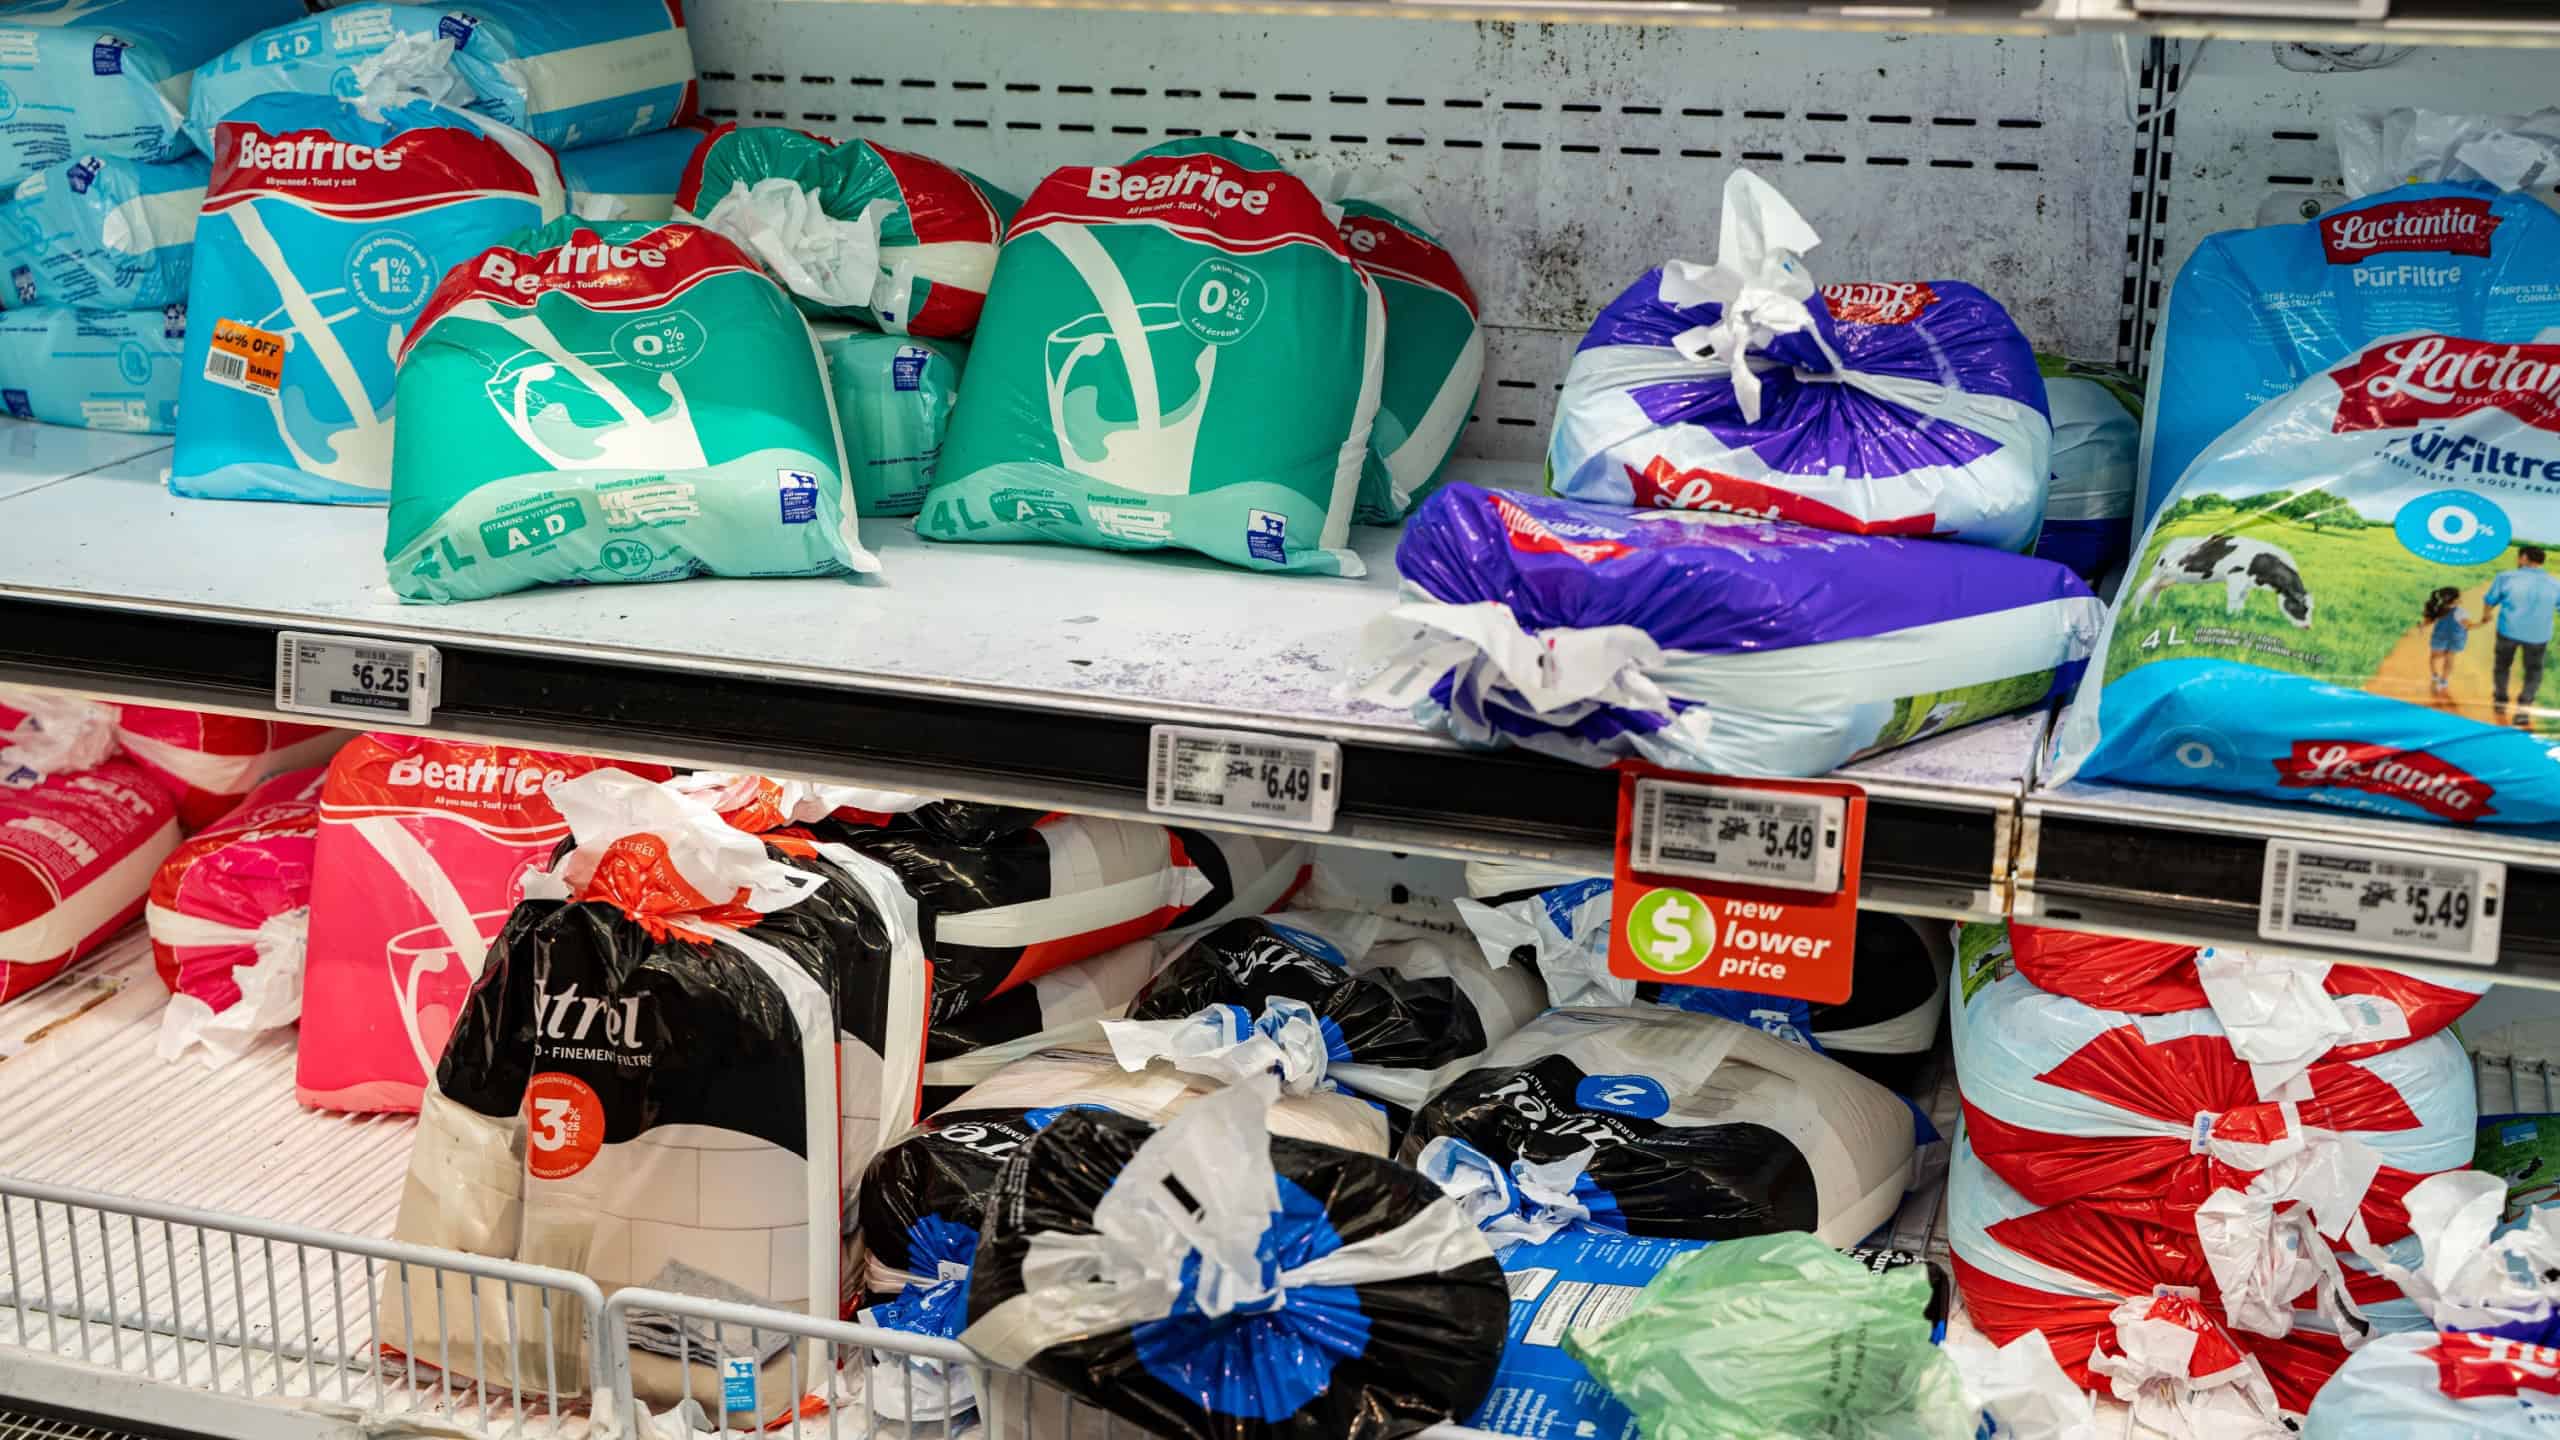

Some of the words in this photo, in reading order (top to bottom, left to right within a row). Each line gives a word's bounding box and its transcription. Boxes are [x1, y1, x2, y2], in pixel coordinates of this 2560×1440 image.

[238, 132, 402, 172] Beatrice
[1087, 164, 1270, 216] Beatrice
[2332, 207, 2477, 250] Lactantia
[479, 241, 667, 295] Betrice
[252, 337, 280, 357] OFF
[249, 365, 278, 380] DAIRY
[2141, 629, 2162, 649] 4
[2168, 625, 2187, 646] L
[352, 663, 410, 693] $6.25
[387, 754, 567, 797] Beatrice
[1724, 900, 1783, 921] new
[2405, 885, 2471, 929] $5.49
[1722, 921, 1832, 960] lower
[1718, 956, 1787, 980] price
[551, 1046, 616, 1063] FINEMEN
